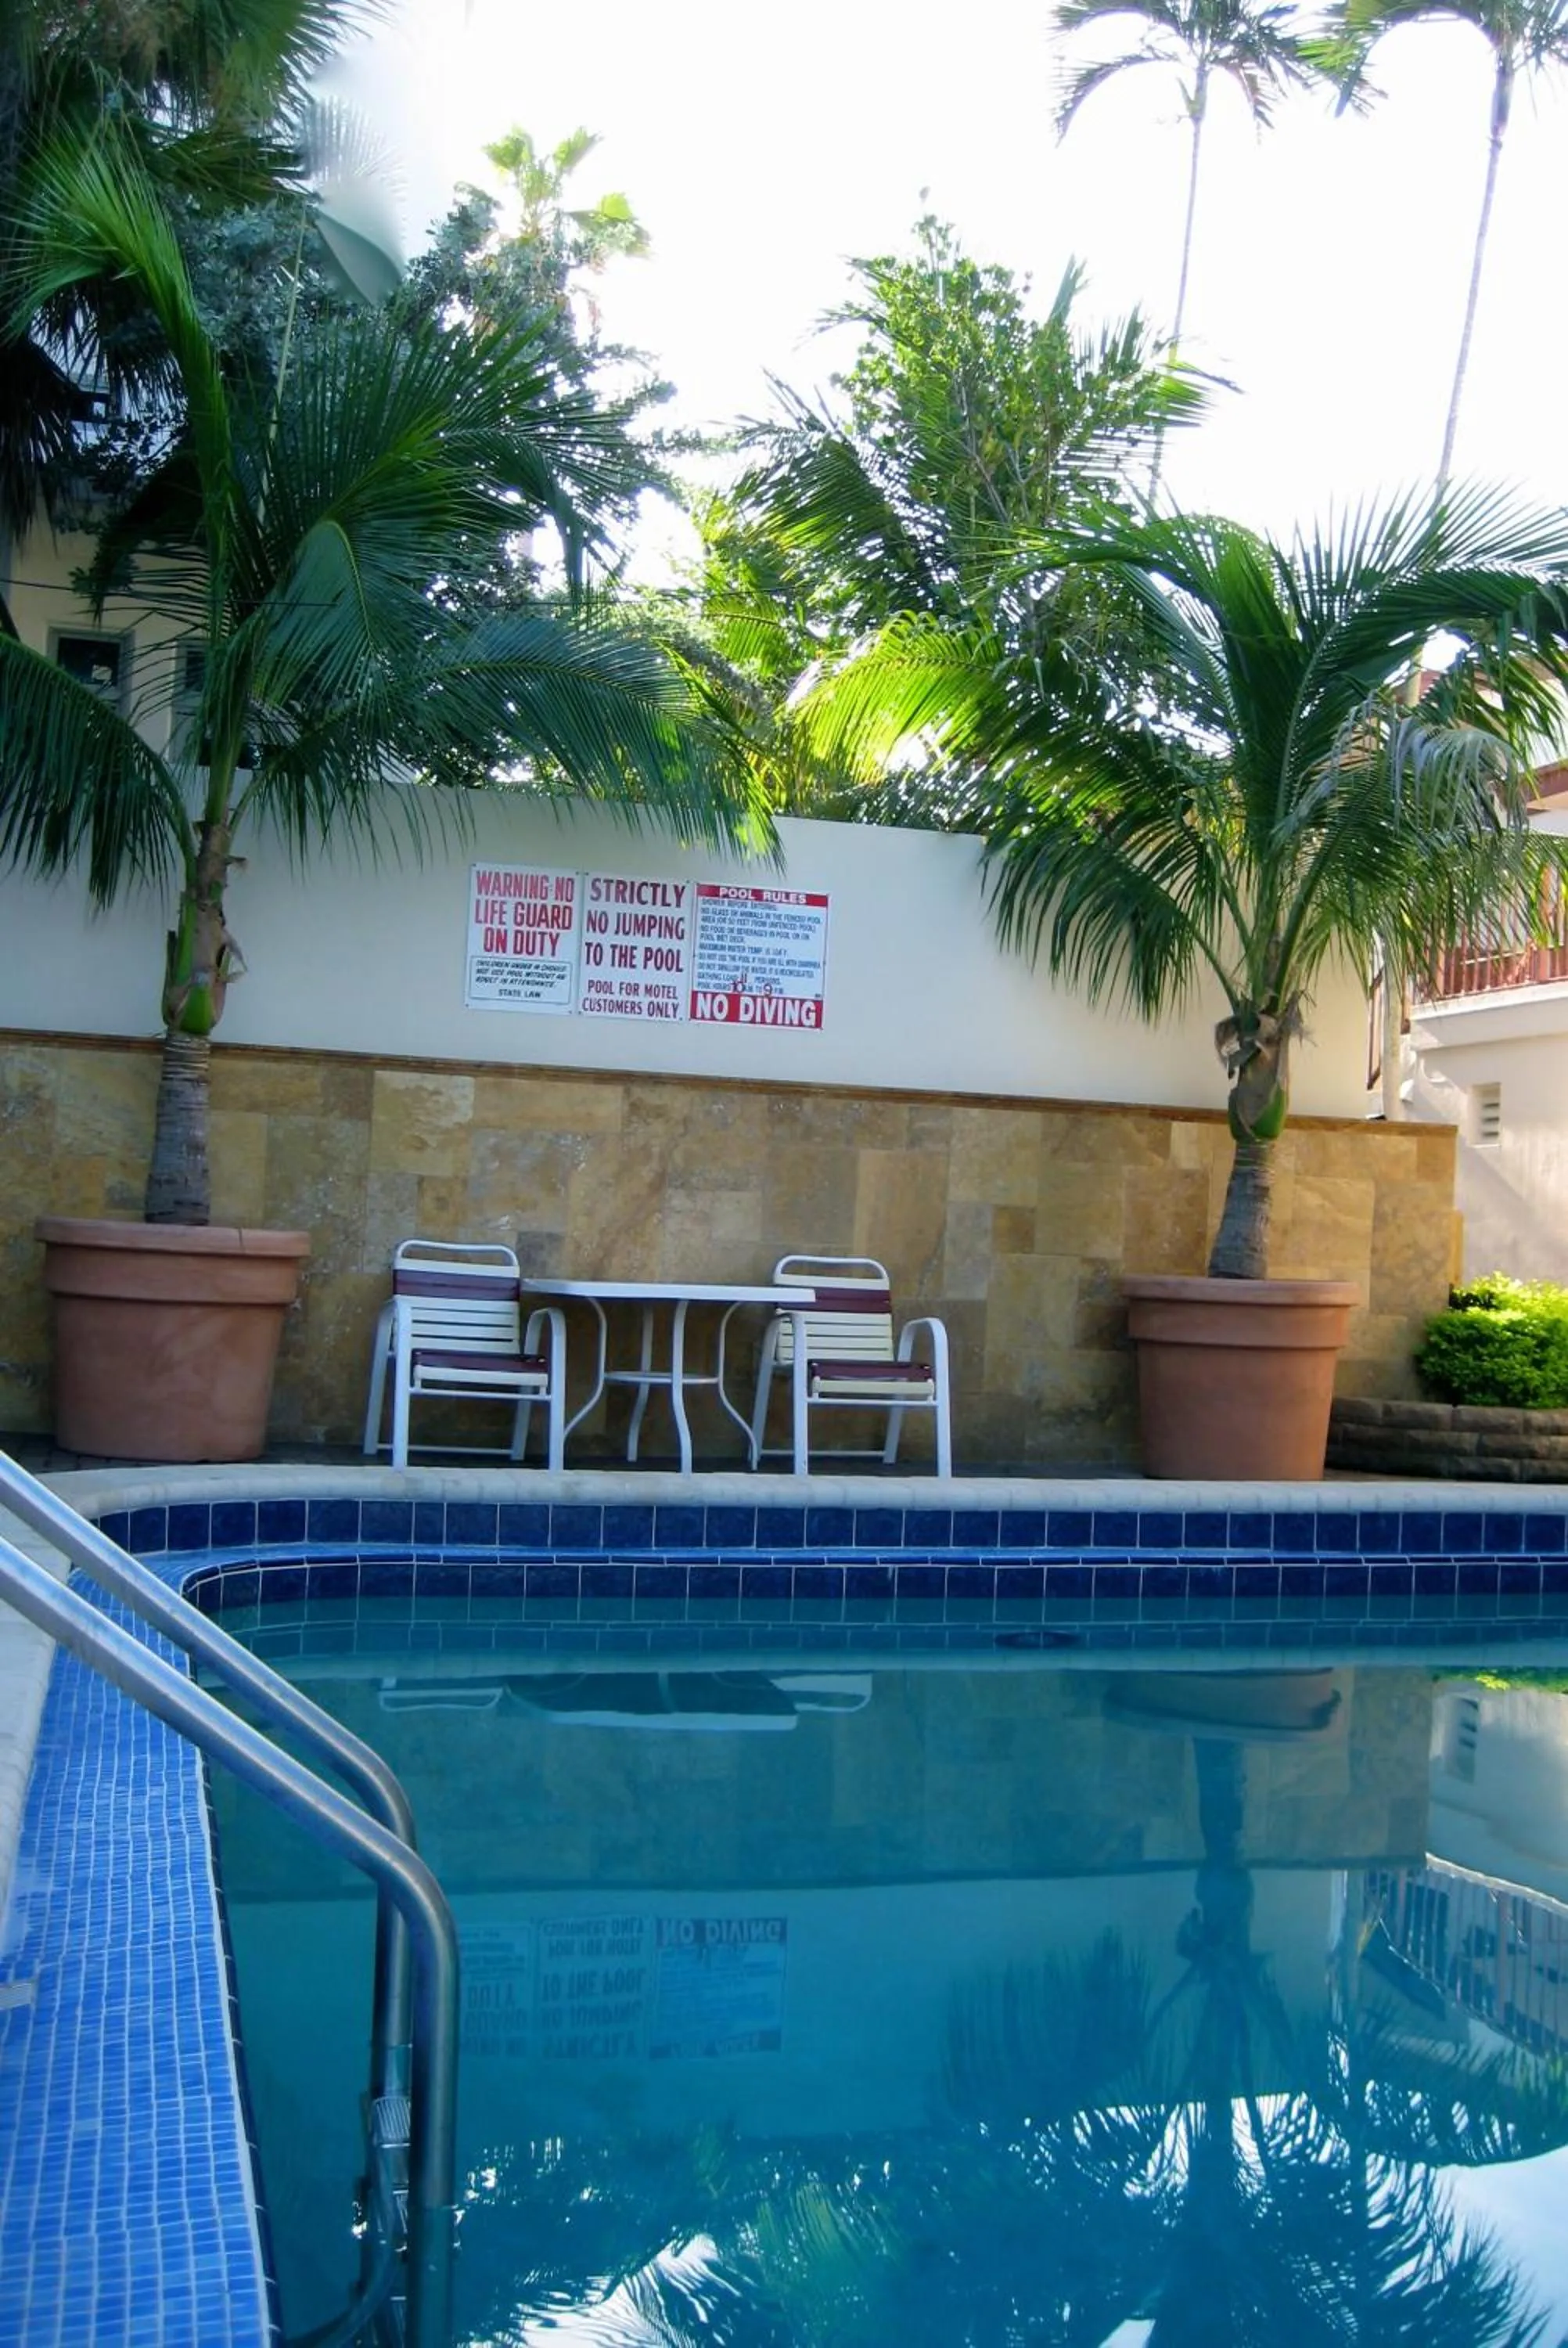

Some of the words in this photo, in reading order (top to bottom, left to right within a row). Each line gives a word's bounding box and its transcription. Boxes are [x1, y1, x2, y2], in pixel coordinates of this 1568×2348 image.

[555, 876, 574, 902] NO
[590, 877, 685, 908] STRICTLY
[719, 887, 755, 900] POOL
[764, 891, 807, 904] RULES
[475, 899, 508, 925] LIFE
[513, 902, 573, 930] GUARD
[587, 909, 609, 935] NO
[614, 913, 685, 940] JUMPING
[484, 927, 508, 953] ON
[513, 930, 559, 957] DUTY
[585, 942, 603, 966] TO
[610, 944, 638, 969] THE
[642, 947, 683, 972] POOL
[499, 989, 521, 997] STATE
[588, 980, 613, 995] POOL
[619, 981, 639, 996] FOR
[644, 983, 678, 1000] MOTEL
[582, 997, 642, 1015] CUSTOMERS
[647, 1001, 679, 1018] ONLY
[695, 992, 728, 1021] NO
[739, 996, 815, 1028] DIVING
